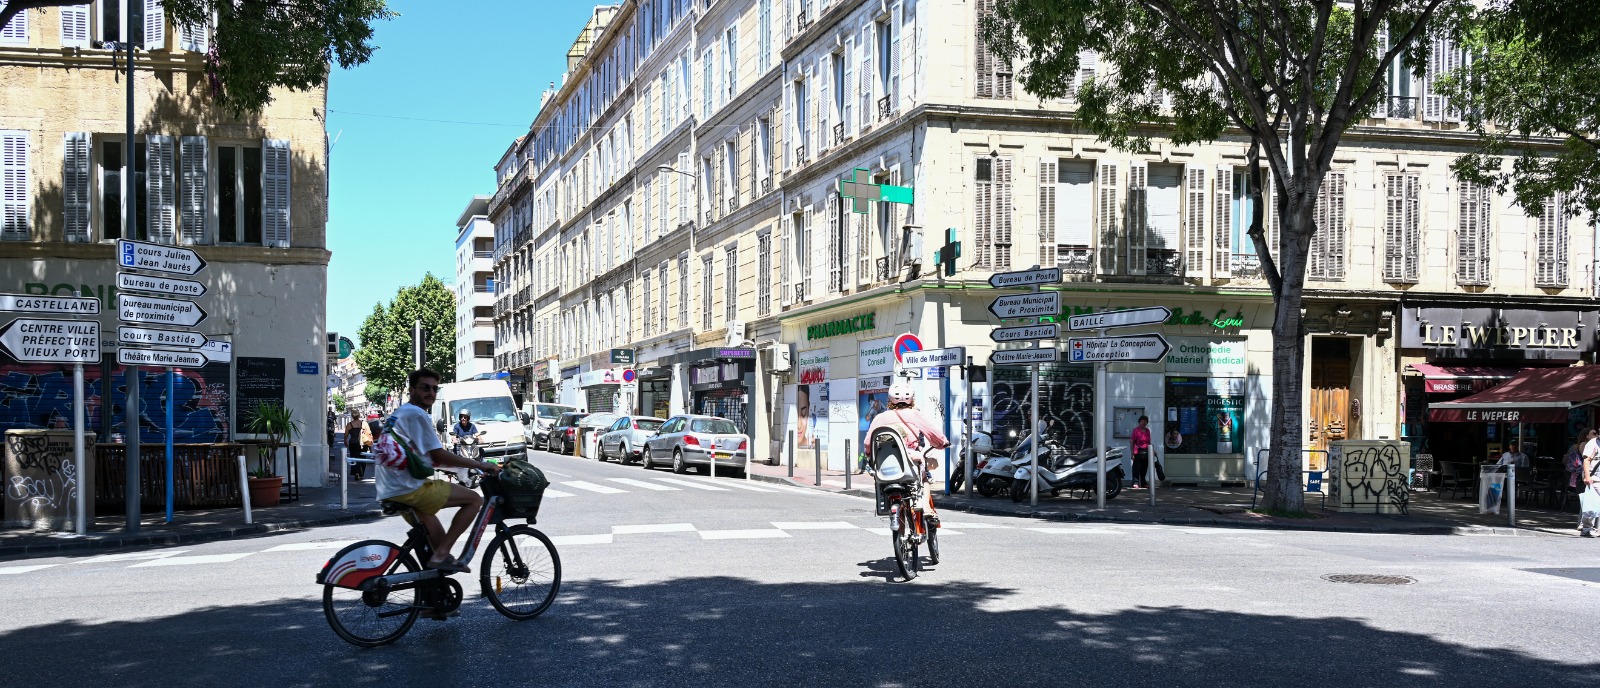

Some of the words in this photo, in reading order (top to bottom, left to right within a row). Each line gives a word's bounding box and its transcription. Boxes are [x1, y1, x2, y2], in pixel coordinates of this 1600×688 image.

[138, 247, 162, 257] cours
[165, 249, 190, 261] Julien
[138, 258, 159, 268] Jean
[163, 260, 191, 272] Jaurès
[998, 275, 1022, 284] Bureau
[1036, 272, 1055, 281] Poste
[124, 277, 156, 288] bureau
[159, 280, 169, 289] de
[173, 284, 198, 293] poste
[16, 299, 96, 311] CASTELLANE
[124, 299, 152, 310] bureau
[154, 302, 192, 314] municipal
[1022, 296, 1054, 306] Municipal
[1020, 305, 1054, 313] Proximité
[124, 310, 134, 318] de
[136, 311, 175, 322] proximité
[807, 312, 875, 340] PHARMACIE
[1074, 317, 1104, 327] BAILLE
[20, 324, 63, 334] CENTRE
[67, 325, 96, 335] VILLE
[1024, 328, 1052, 337] Bastide
[22, 334, 96, 346] PRÉFECTURE
[124, 332, 152, 341] cours
[158, 333, 196, 344] Bastide
[1422, 324, 1457, 346] LE
[1466, 325, 1579, 347] WEPLER
[1086, 341, 1108, 349] Hôpital
[1120, 340, 1156, 348] Conception
[1179, 344, 1231, 355] Orthopédie
[24, 348, 58, 357] VIEUX
[65, 349, 96, 358] PORT
[861, 345, 893, 356] Homéopathie
[1086, 350, 1130, 358] Conception
[124, 352, 151, 361] théâtre
[153, 353, 173, 362] Marie
[174, 355, 199, 364] Jeanne
[815, 355, 829, 364] Beauté
[868, 357, 886, 366] Conseil
[906, 356, 918, 364] Ville
[929, 352, 957, 361] Marseille
[1167, 356, 1203, 364] Matériel
[1208, 356, 1244, 365] médical
[1467, 411, 1477, 420] LE
[1482, 411, 1520, 421] WEPLER
